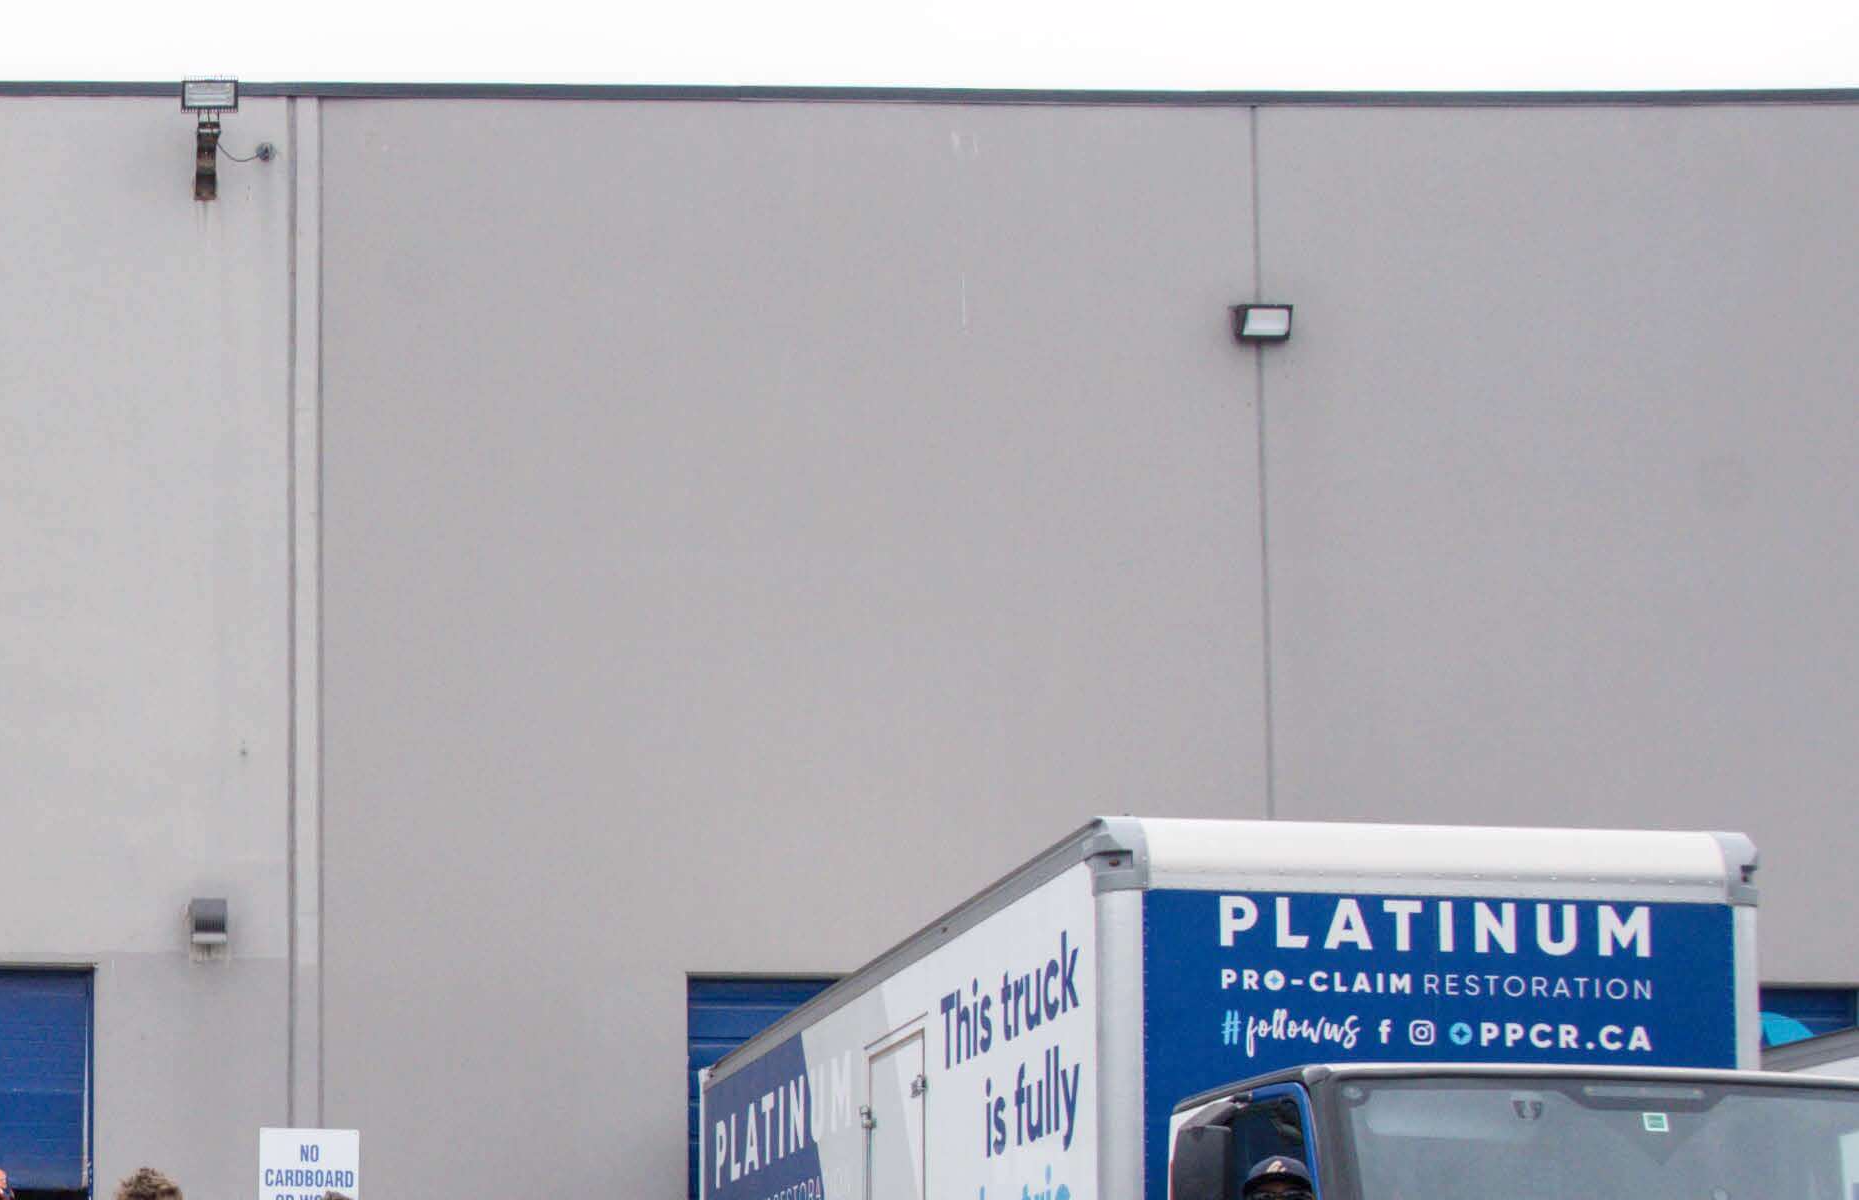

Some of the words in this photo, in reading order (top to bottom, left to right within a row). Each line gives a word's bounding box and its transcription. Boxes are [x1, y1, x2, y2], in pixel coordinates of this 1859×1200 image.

[1219, 895, 1651, 958] PLATINUM
[940, 976, 992, 1070] This
[1001, 929, 1080, 1042] truck
[1220, 968, 1412, 994] PRO-CLAIM
[1423, 973, 1652, 1000] RESTORATION
[715, 1050, 853, 1190] PLATINUM
[985, 1076, 1006, 1158] is
[1014, 1045, 1081, 1152] fully
[264, 1168, 354, 1188] CARDBOARD
[300, 1144, 320, 1162] NO
